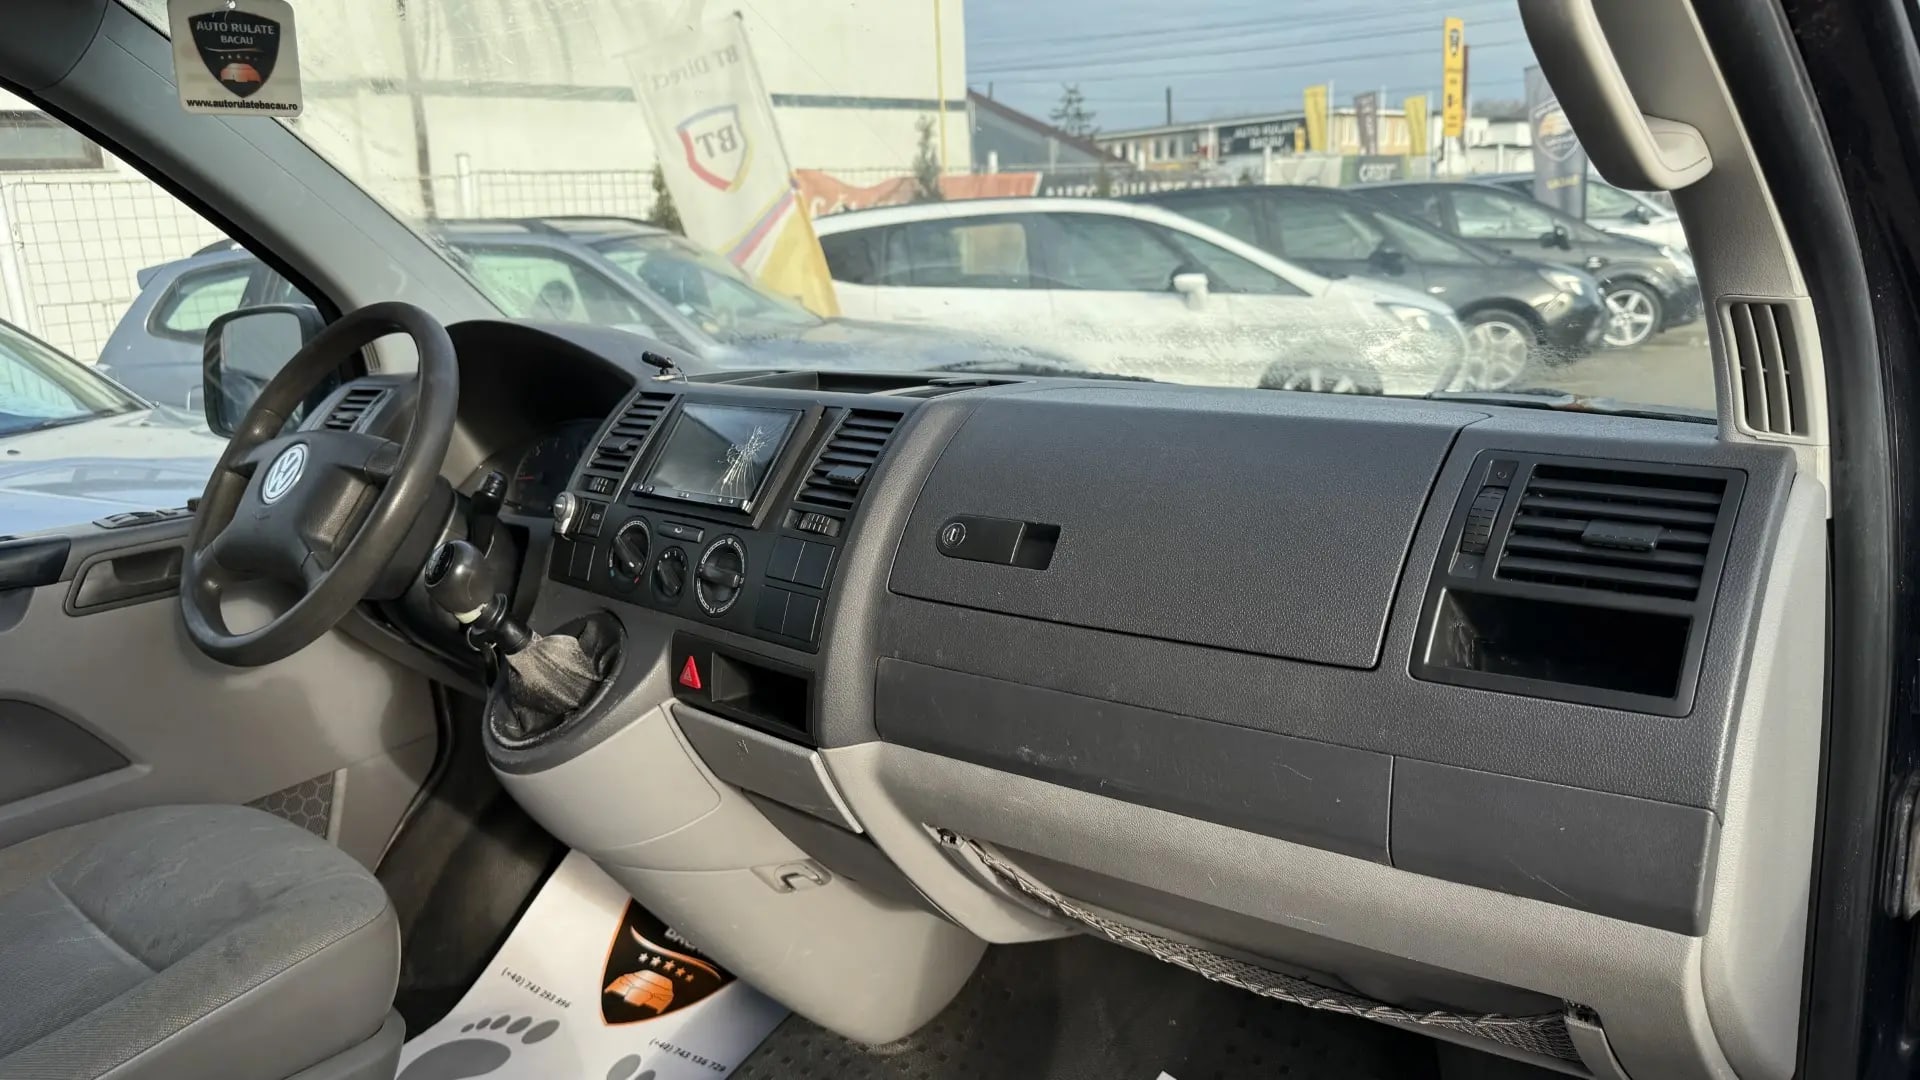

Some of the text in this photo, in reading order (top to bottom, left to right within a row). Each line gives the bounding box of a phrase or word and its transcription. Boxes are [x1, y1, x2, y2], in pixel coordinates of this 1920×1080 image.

[196, 20, 276, 35] AUTO RULATE
[220, 35, 254, 45] BACAU
[186, 98, 298, 111] www.autorulatebacau.ro
